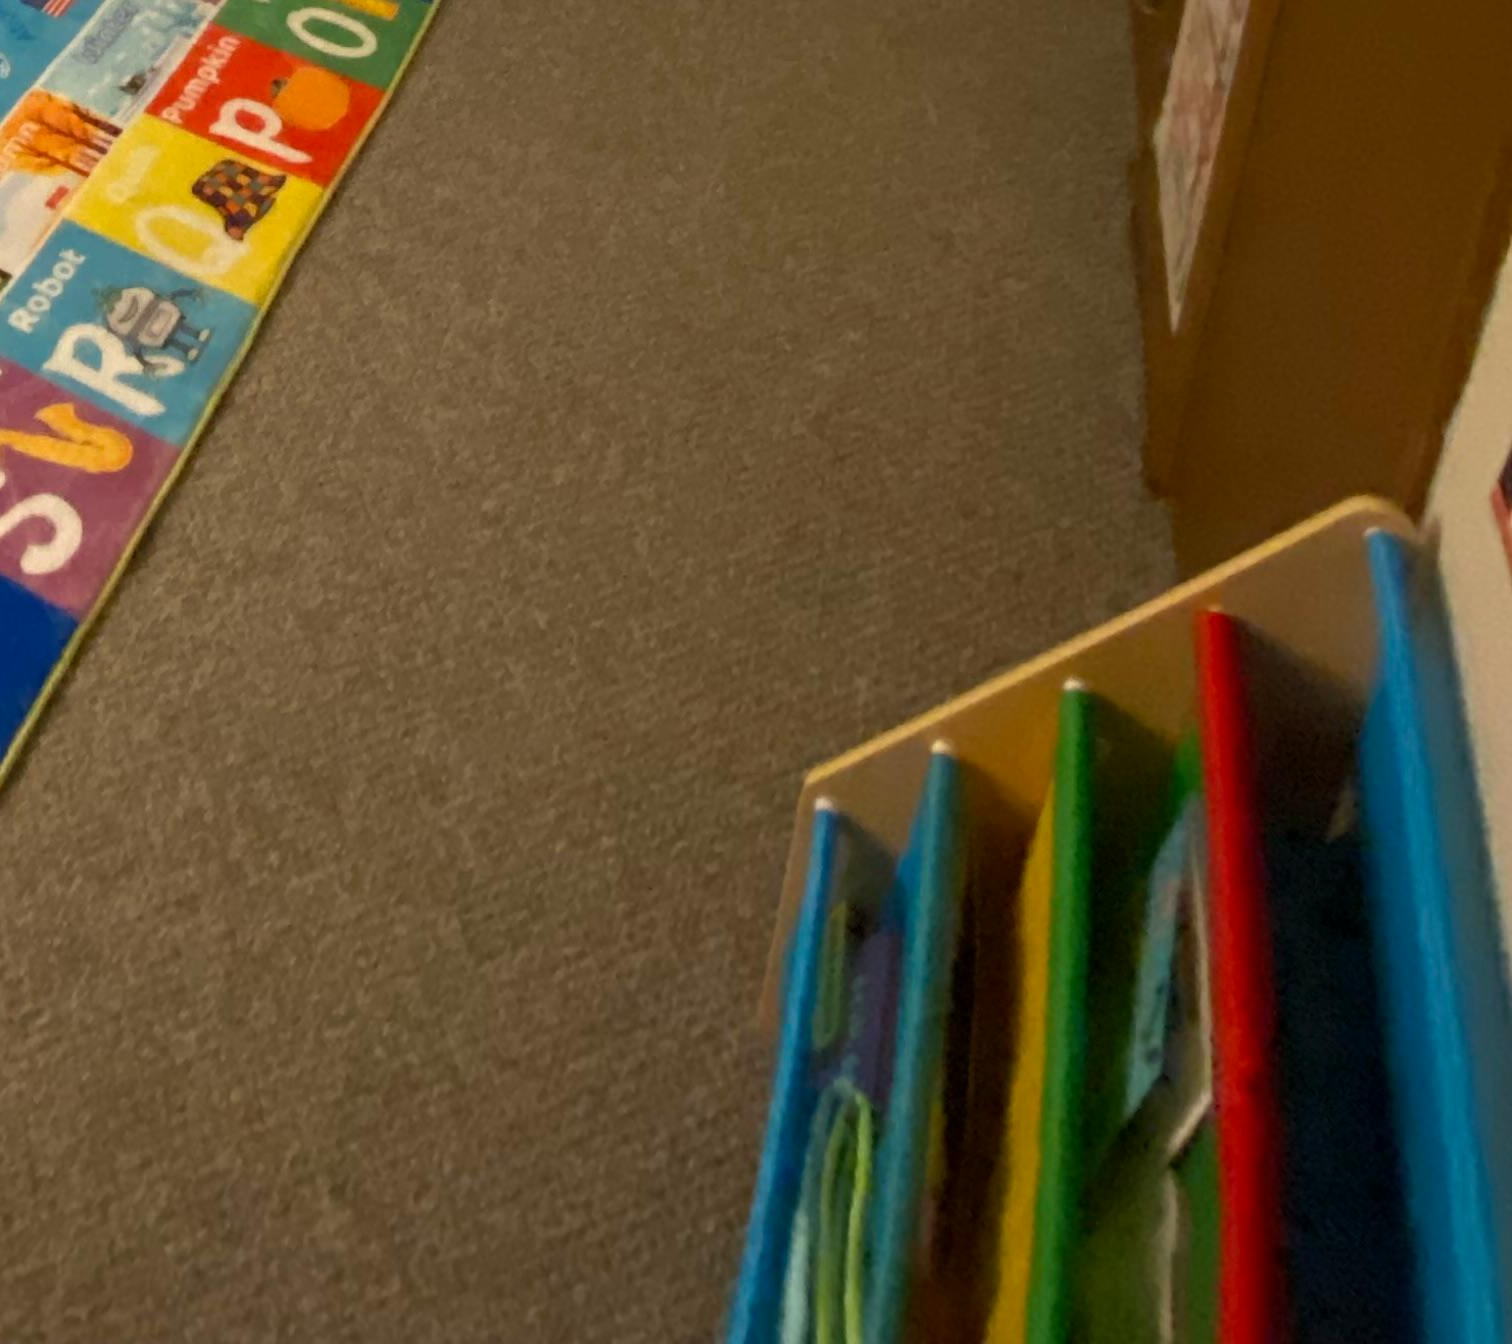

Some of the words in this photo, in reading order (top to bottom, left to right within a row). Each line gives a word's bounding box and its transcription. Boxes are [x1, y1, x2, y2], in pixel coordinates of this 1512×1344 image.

[285, 6, 378, 60] O
[160, 35, 243, 126] Pumpkin
[207, 97, 314, 163] P
[135, 204, 252, 275] Q
[6, 249, 87, 335] Robot
[40, 322, 186, 416] R
